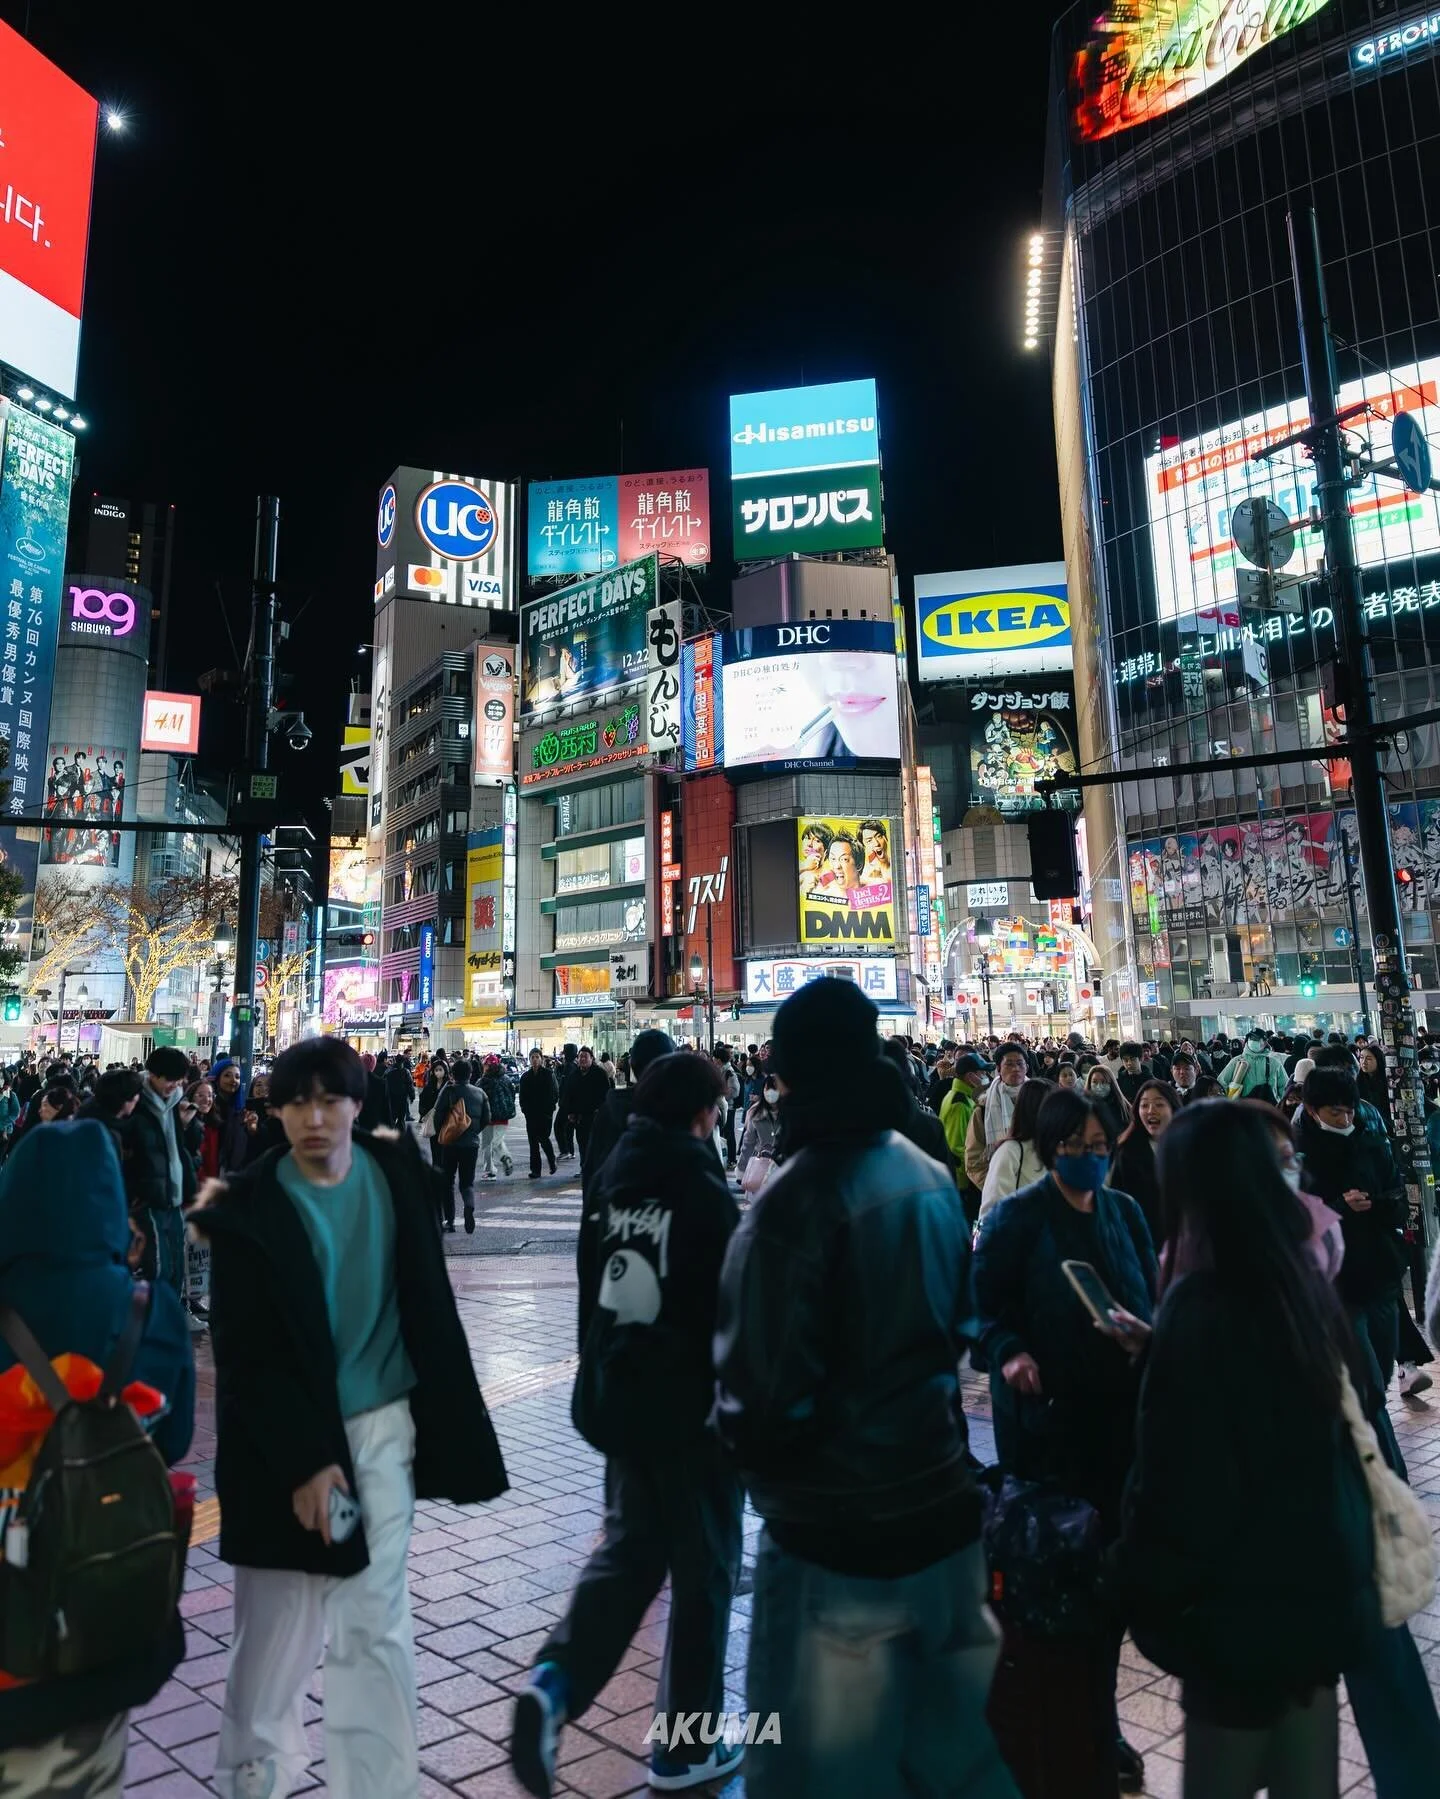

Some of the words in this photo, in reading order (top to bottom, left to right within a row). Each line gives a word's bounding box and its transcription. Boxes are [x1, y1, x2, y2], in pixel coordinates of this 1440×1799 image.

[1357, 15, 1440, 64] QFRON
[733, 416, 875, 444] Hisamitsu
[8, 433, 69, 478] PERFECT
[20, 458, 55, 490] DAYS
[94, 508, 126, 519] INDIGO
[547, 496, 600, 522] 龍角散
[638, 489, 691, 515] 龍角散
[741, 488, 873, 533] サロンパス
[426, 498, 489, 541] UC
[630, 514, 702, 540] ダイレクト
[540, 521, 610, 547] ダイレクト
[467, 579, 501, 594] VISA
[69, 586, 136, 636] 109
[528, 587, 596, 636] PERFECT
[601, 567, 645, 608] DAYS
[71, 621, 111, 635] SHIBUYA
[936, 603, 1066, 637] IKEA
[777, 625, 830, 647] DHC
[622, 648, 649, 669] 12.22
[649, 608, 681, 744] もんじゃ
[10, 585, 43, 816] 第76回カンヌ国際映画祭
[970, 690, 1070, 711] ダンジョン飯
[154, 711, 184, 732] H&M
[784, 761, 802, 769] DHC
[803, 759, 834, 768] Channel
[969, 894, 1007, 904] クリニック
[978, 885, 1007, 895] れいわ
[805, 911, 892, 938] DMM
